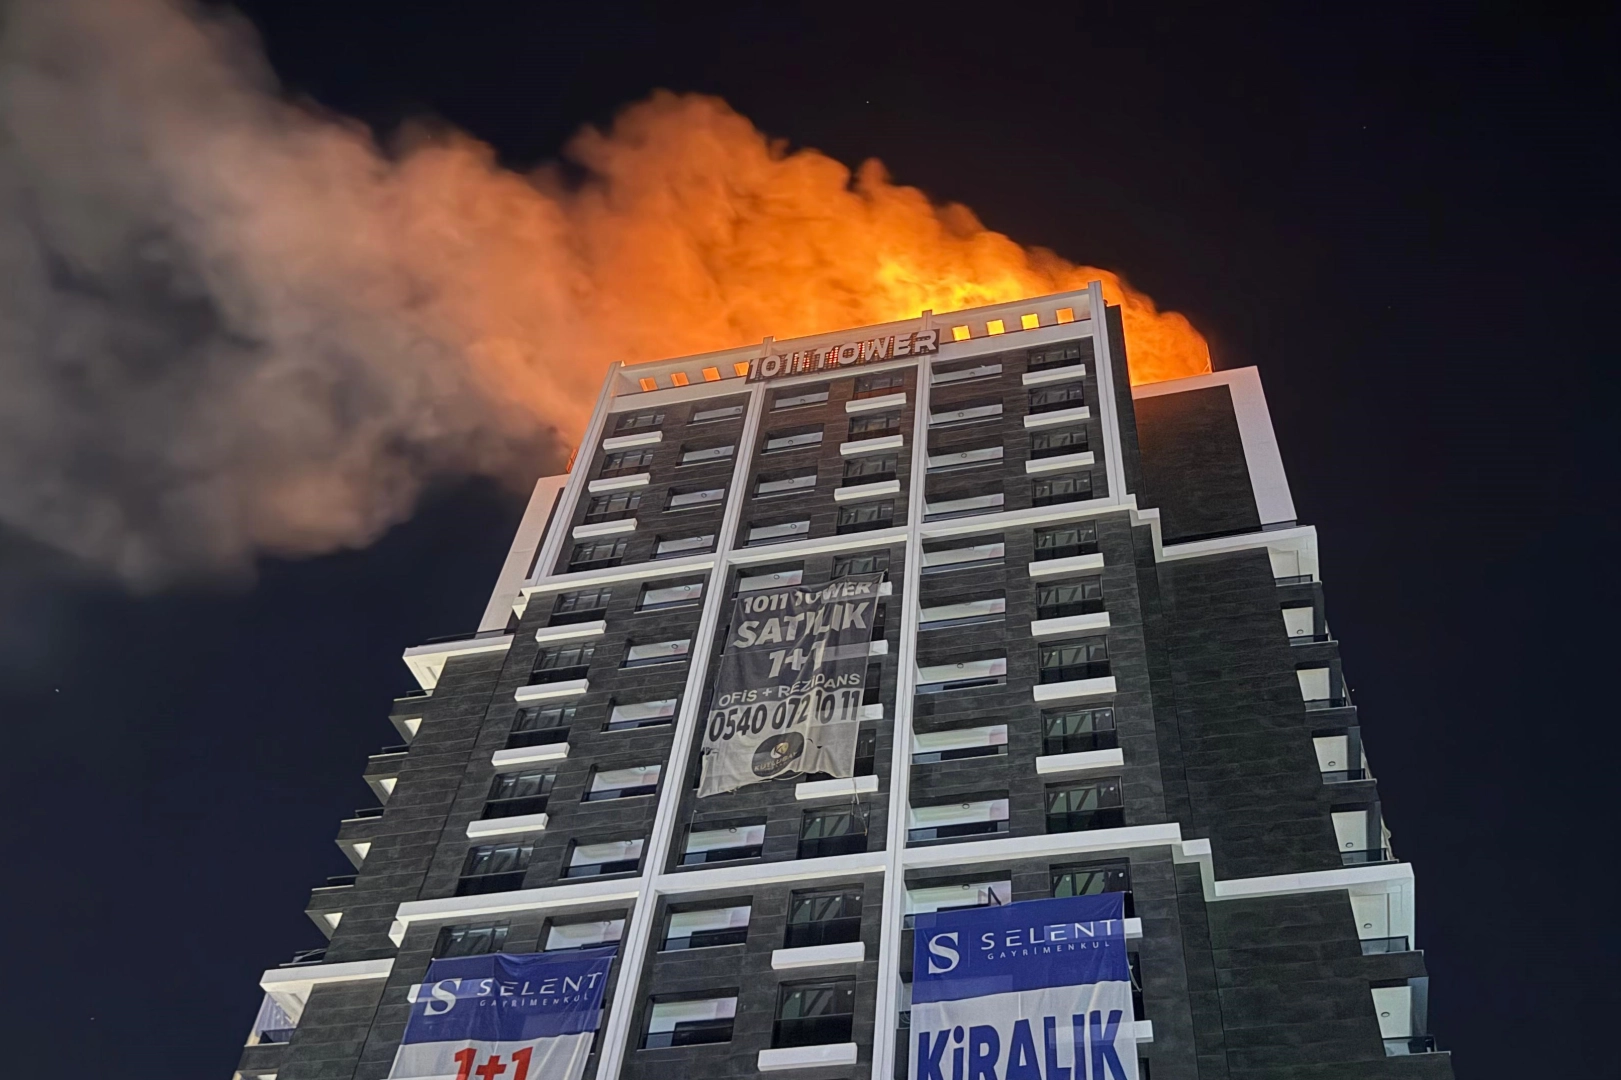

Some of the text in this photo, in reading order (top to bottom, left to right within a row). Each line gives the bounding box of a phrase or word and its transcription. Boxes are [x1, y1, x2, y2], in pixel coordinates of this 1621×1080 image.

[749, 330, 937, 380] 1011 TOWER
[743, 593, 788, 614] 1011
[733, 601, 870, 649] SATILIK
[768, 639, 826, 679] 1+1
[709, 703, 767, 742] 0540
[771, 695, 811, 730] 072
[841, 690, 861, 721] 11
[981, 919, 1117, 950] SELENT
[476, 972, 603, 997] SELENT
[454, 1046, 533, 1080] 1+1
